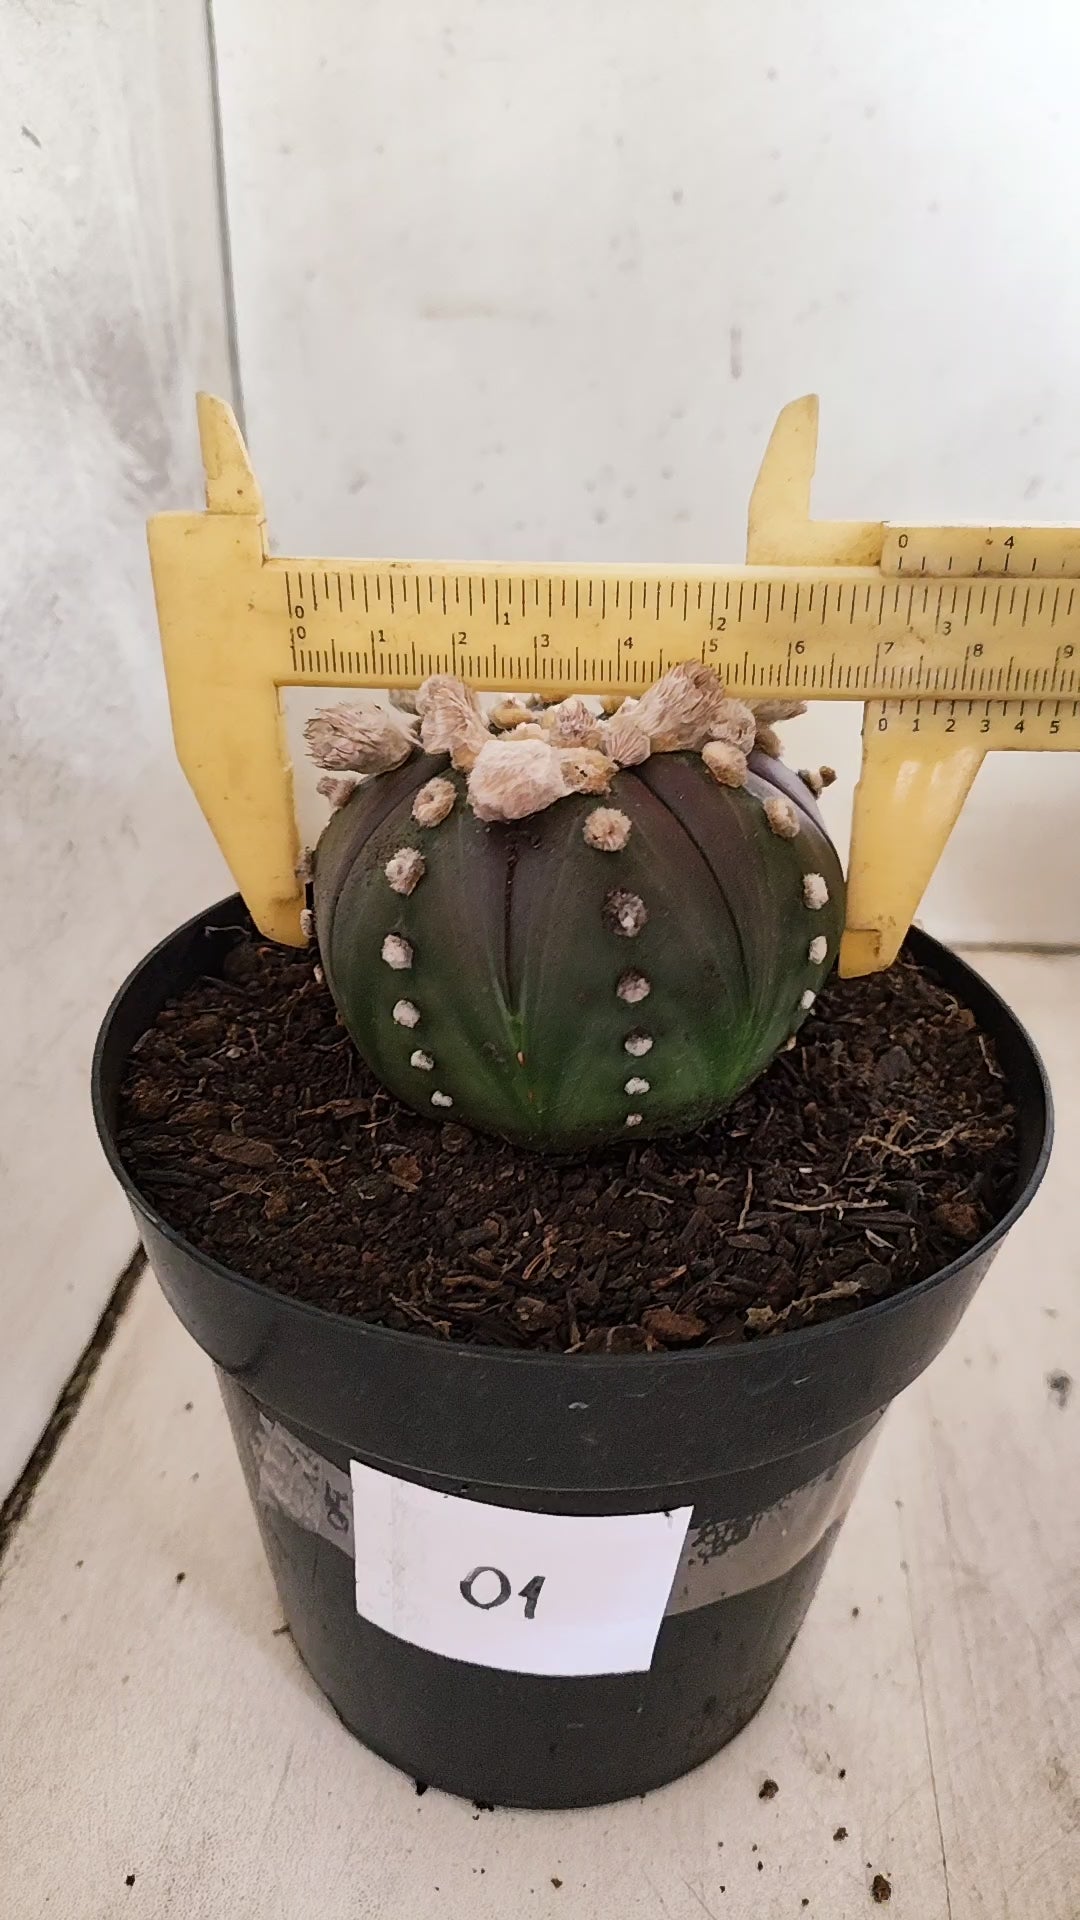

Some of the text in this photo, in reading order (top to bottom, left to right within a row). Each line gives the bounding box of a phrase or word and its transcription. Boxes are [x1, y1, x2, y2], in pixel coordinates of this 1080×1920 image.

[898, 534, 1015, 549] 0 4
[294, 605, 952, 636] 0 1 2 3
[296, 626, 1074, 658] 0 1 2 3 4 5 6 7 8 9
[878, 718, 1060, 734] 0 1 2 3 4 5
[460, 1566, 546, 1619] 01
